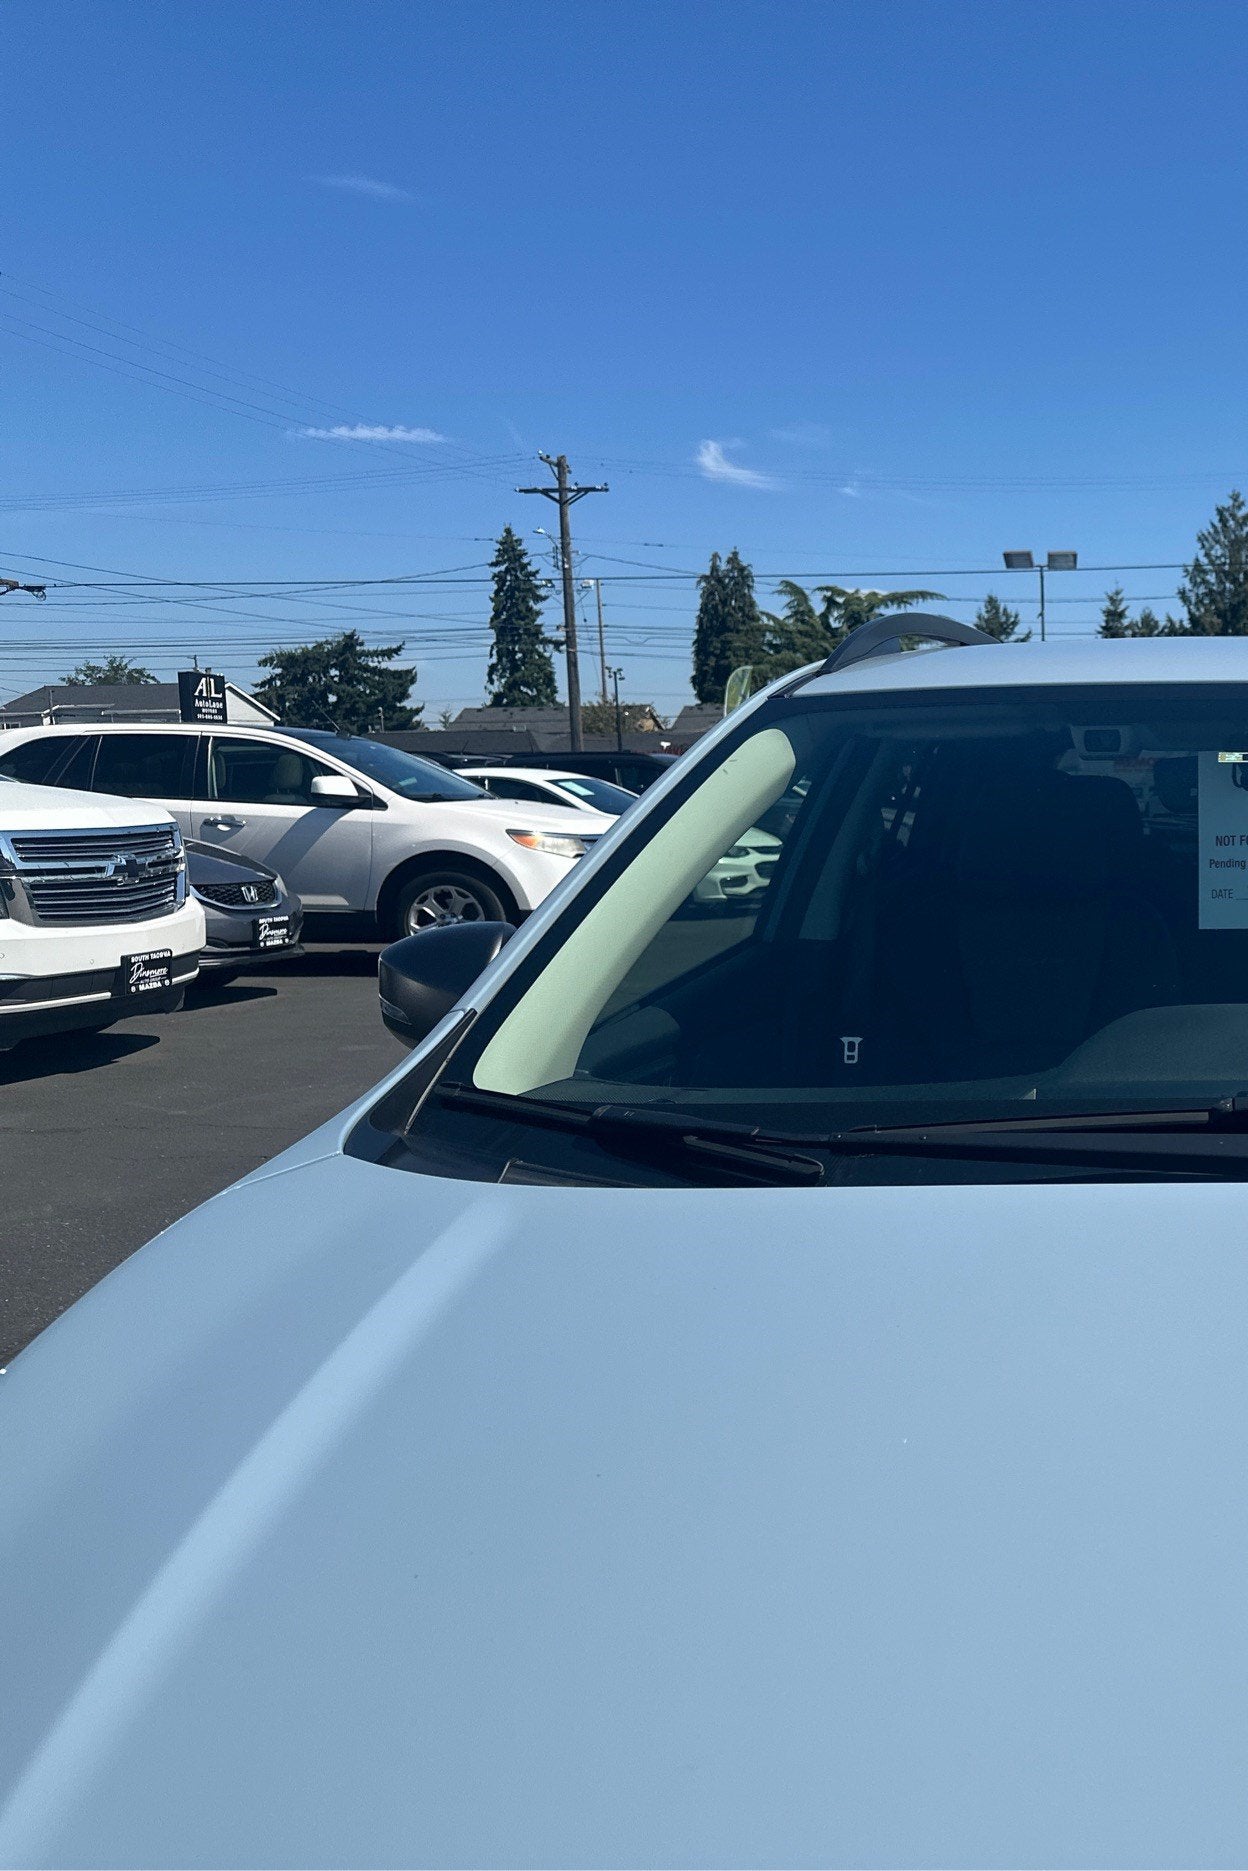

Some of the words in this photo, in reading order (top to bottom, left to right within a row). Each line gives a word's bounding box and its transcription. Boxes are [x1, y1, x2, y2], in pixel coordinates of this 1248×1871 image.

[195, 699, 223, 708] AutoLane
[1215, 835, 1237, 847] NOT
[1209, 858, 1247, 870] Pending
[1211, 888, 1234, 899] DATE
[131, 954, 150, 963] SOUTH
[150, 950, 171, 960] TACOMA
[138, 981, 162, 991] MAZDA
